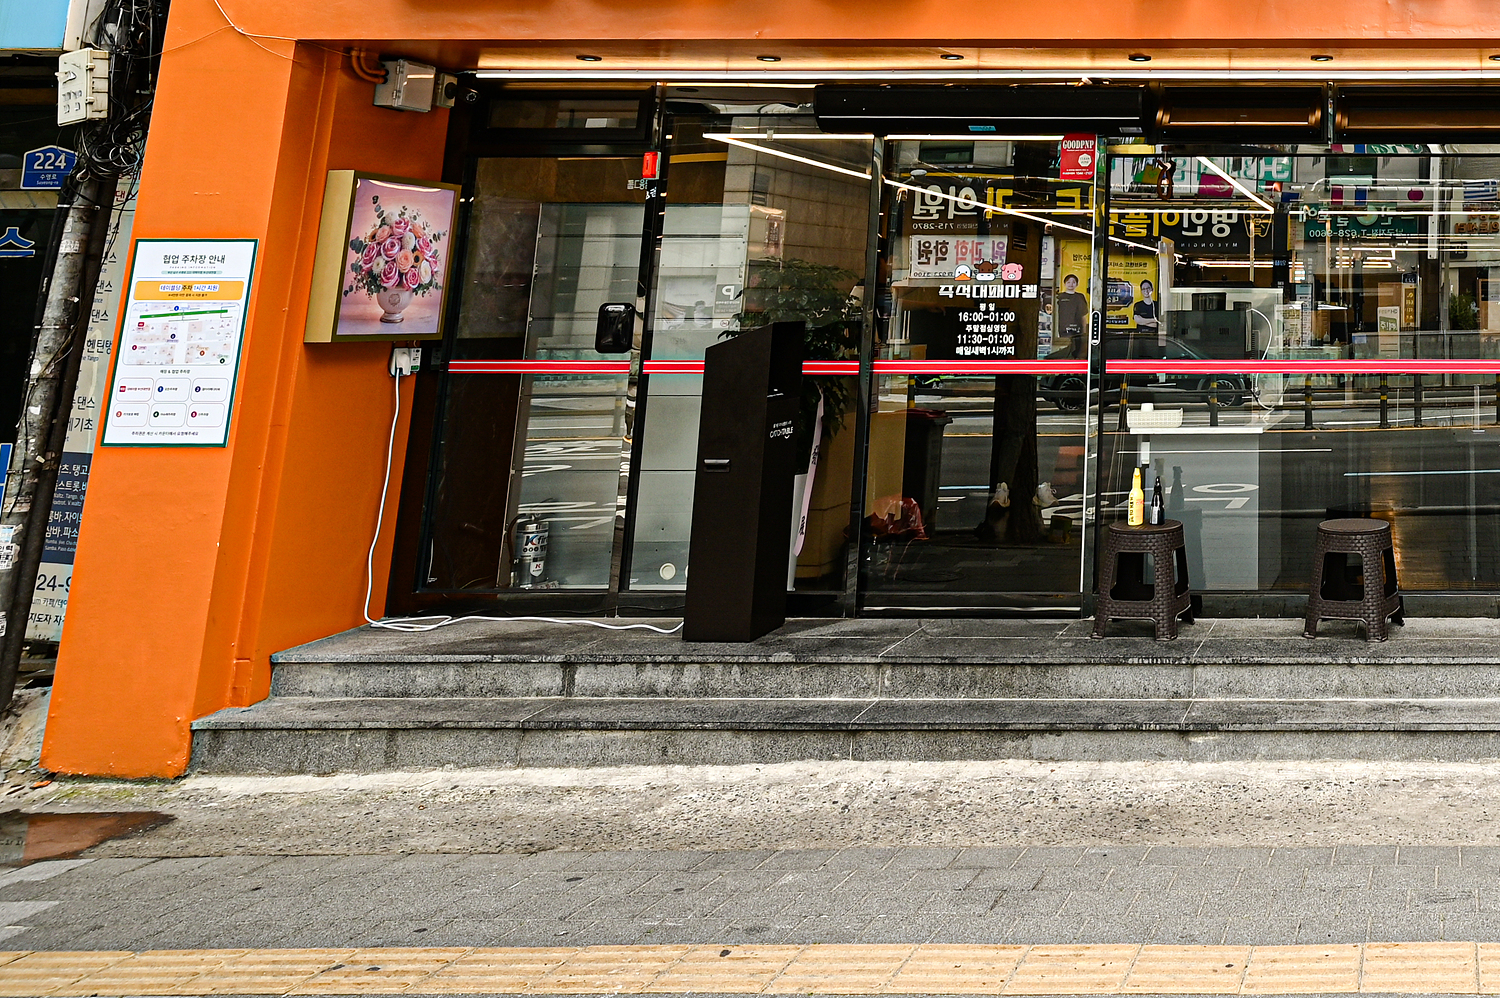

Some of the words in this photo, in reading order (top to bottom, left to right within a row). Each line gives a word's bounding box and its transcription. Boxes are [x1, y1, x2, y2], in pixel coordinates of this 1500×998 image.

[33, 152, 67, 170] 224
[182, 254, 206, 264] 주차장
[208, 254, 226, 264] 안내
[958, 312, 1015, 322] 16:00-01:00
[957, 334, 1015, 344] 11:30-01:00
